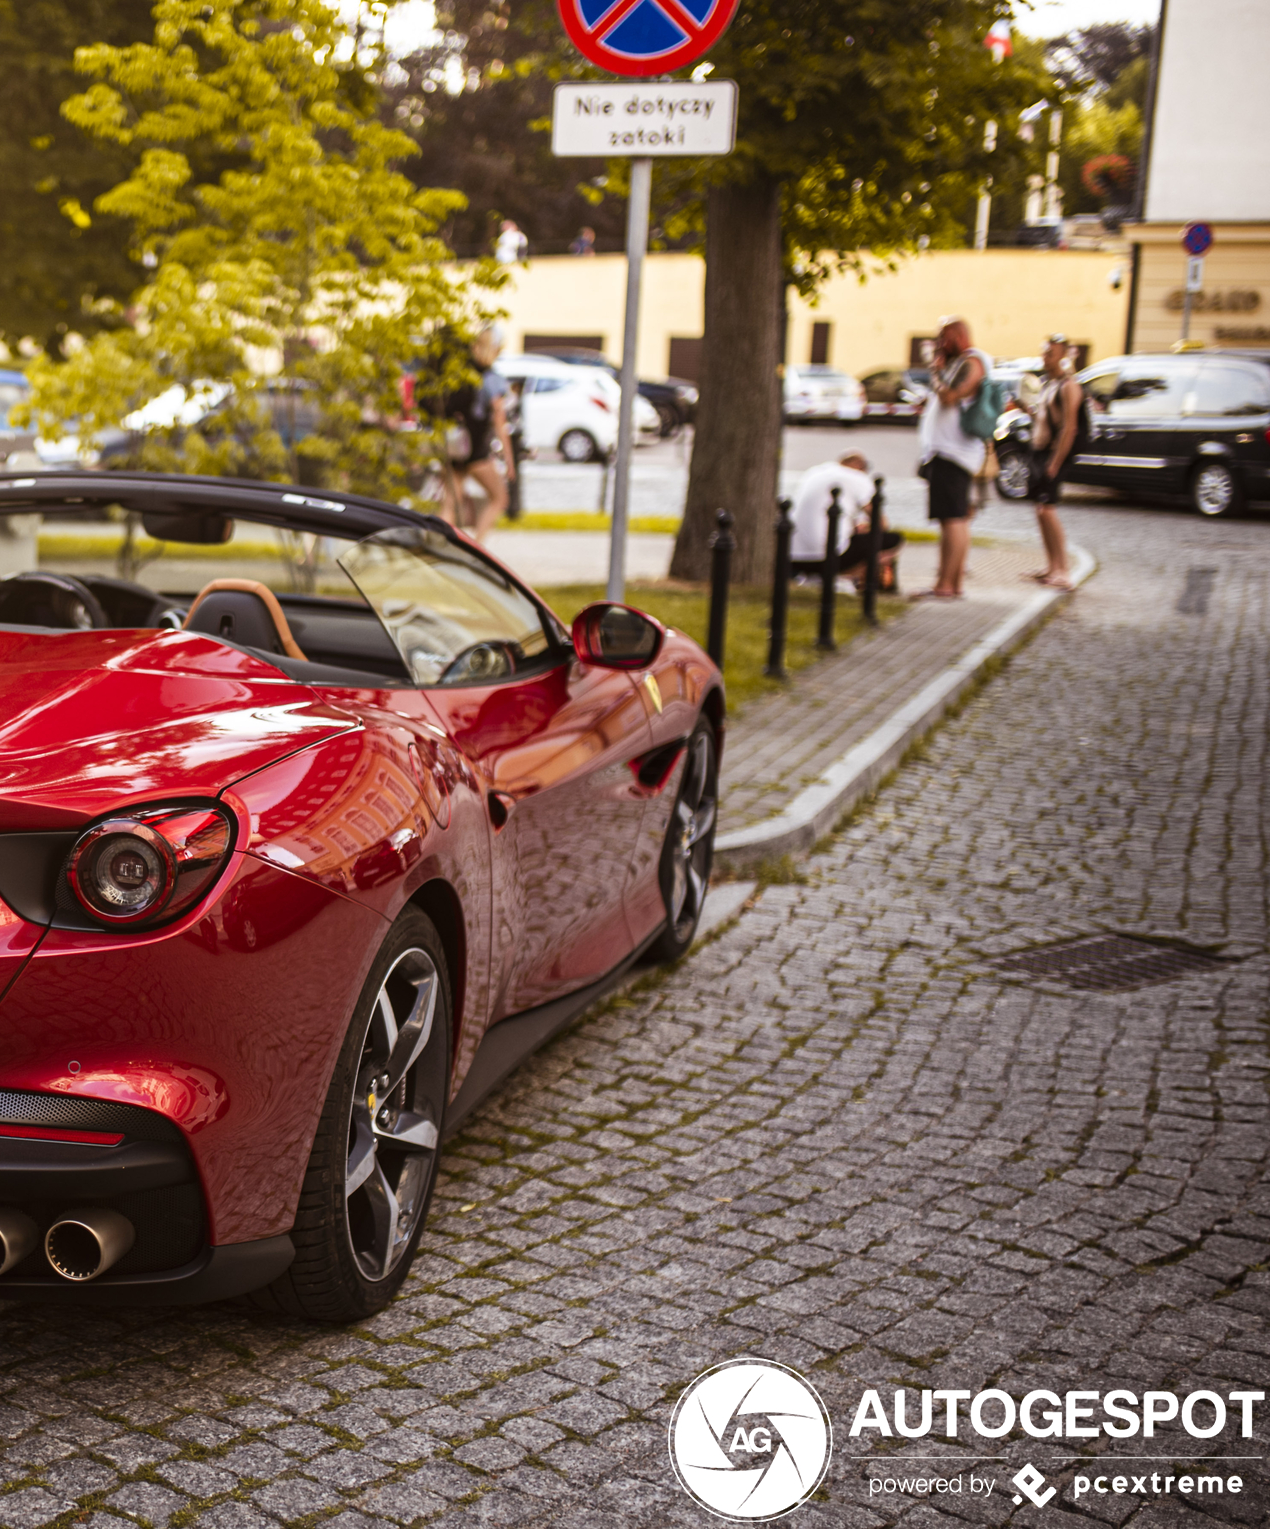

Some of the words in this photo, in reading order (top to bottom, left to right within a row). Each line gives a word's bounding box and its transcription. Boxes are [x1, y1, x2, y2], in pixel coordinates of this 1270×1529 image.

[575, 96, 614, 116] Nie
[625, 95, 715, 120] dotyczy
[610, 126, 686, 146] zatoki
